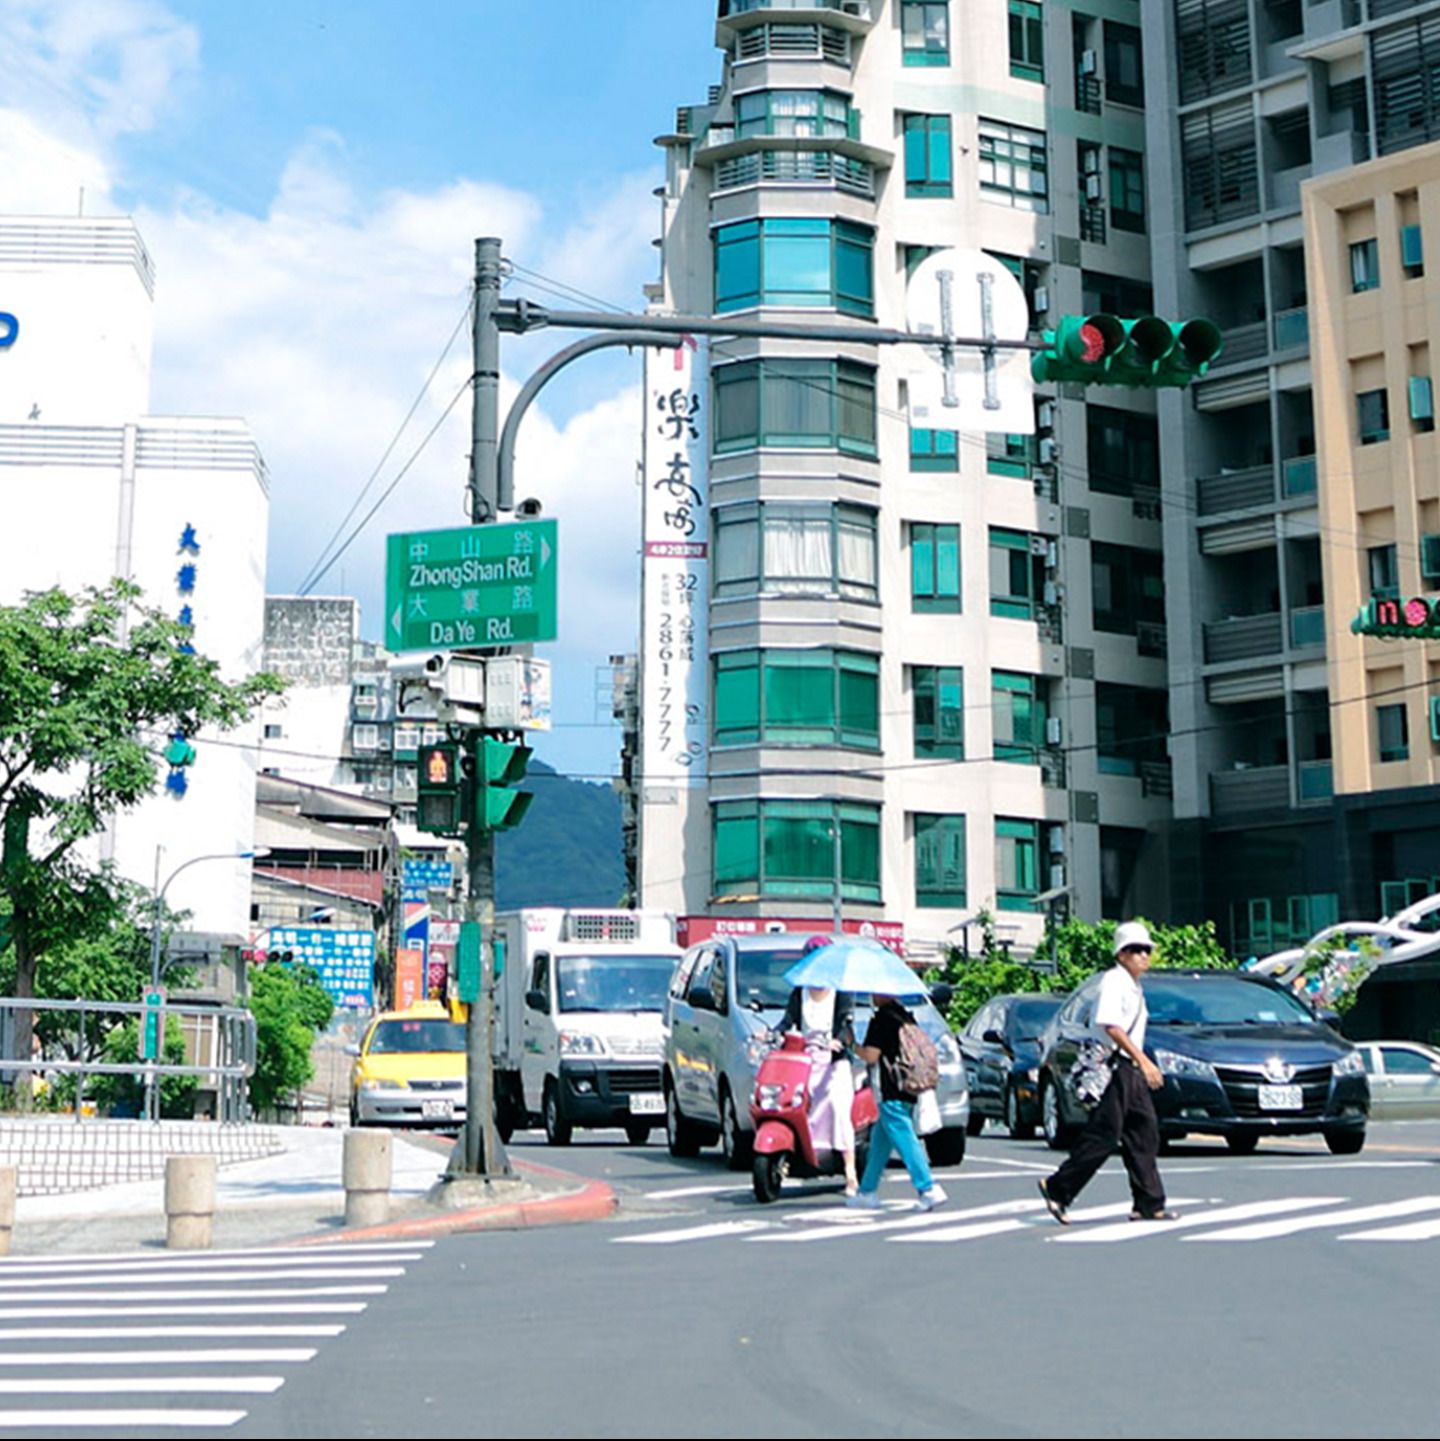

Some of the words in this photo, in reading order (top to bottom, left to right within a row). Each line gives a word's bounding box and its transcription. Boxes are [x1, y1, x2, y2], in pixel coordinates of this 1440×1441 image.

[409, 530, 533, 562] 中山路
[410, 559, 504, 589] ZhongShan
[507, 557, 533, 578] Rd.
[409, 586, 532, 618] 大業路
[487, 618, 514, 641] Rd.
